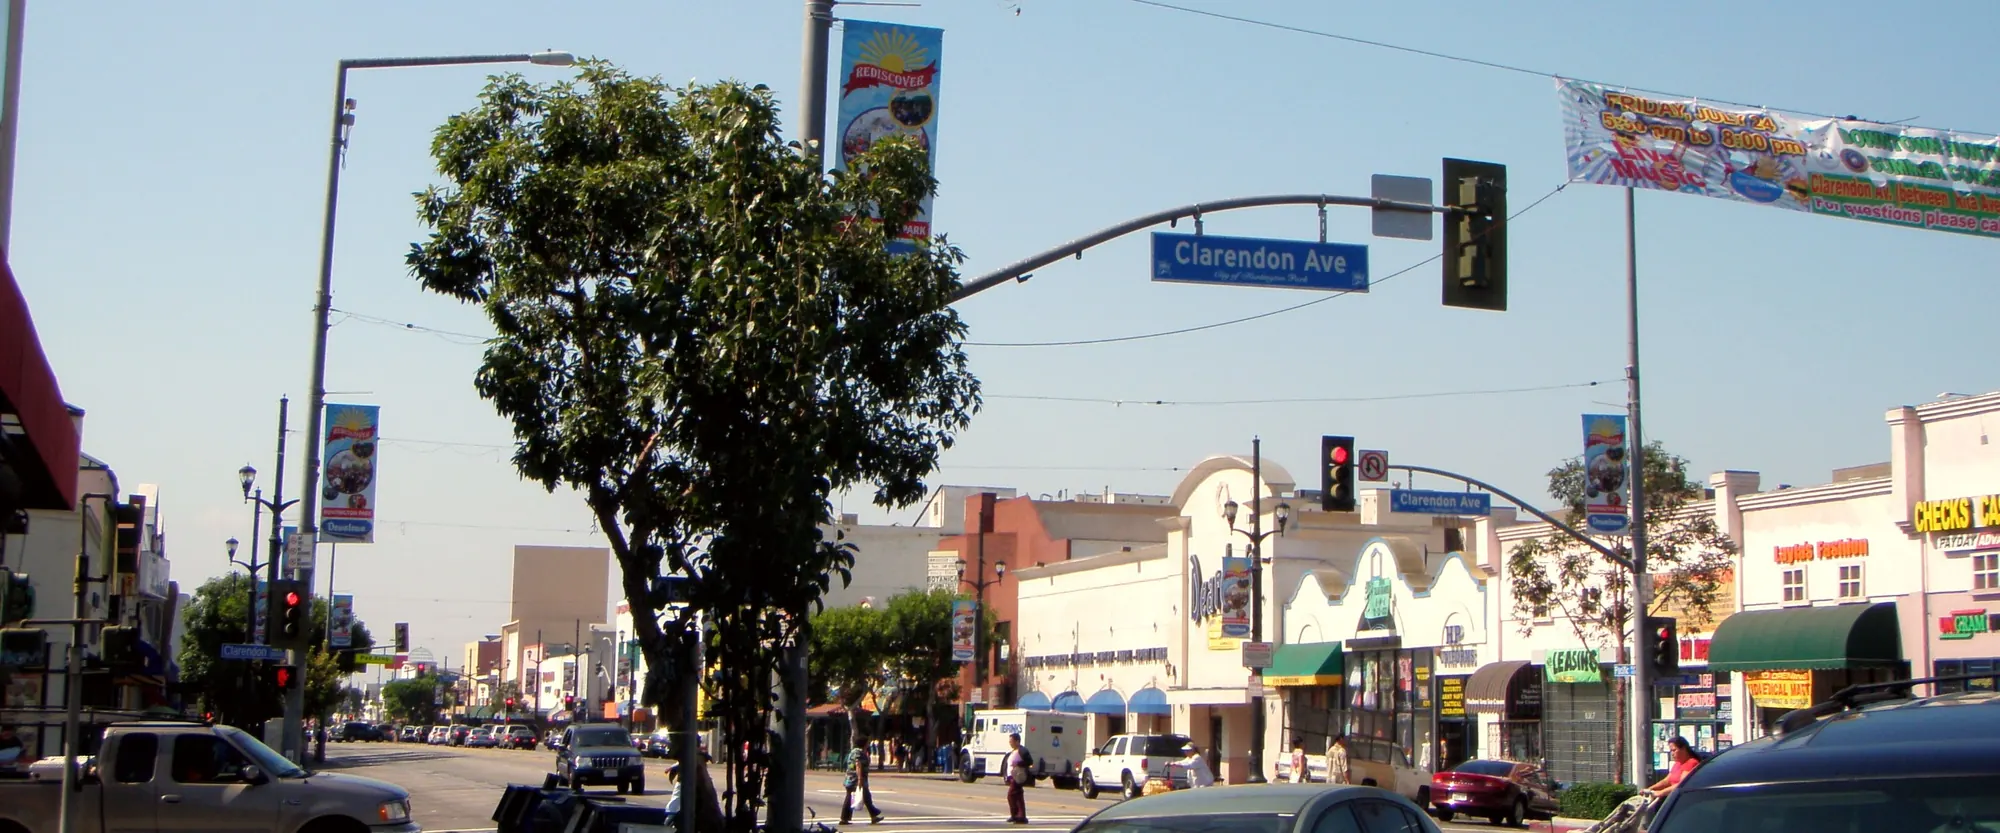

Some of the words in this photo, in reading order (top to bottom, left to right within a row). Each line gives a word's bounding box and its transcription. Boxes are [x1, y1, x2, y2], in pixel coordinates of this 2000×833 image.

[855, 66, 925, 87] REDISCOVER
[1604, 93, 1692, 122] FRIDAY,
[1696, 107, 1745, 127] JULY
[1748, 114, 1778, 133] 24
[1687, 126, 1712, 146] to
[1720, 128, 1768, 151] 8:00
[1769, 137, 1807, 156] pm
[1811, 173, 1873, 199] Clarendon
[1844, 203, 1922, 223] questions
[1926, 211, 1977, 229] please
[1175, 240, 1294, 270] Clarendon
[1303, 248, 1348, 274] Ave
[1400, 493, 1456, 507] Clarendon
[1460, 495, 1481, 508] Ave
[1914, 496, 1971, 532] CHECKS
[1816, 538, 1869, 560] Fashion
[1939, 535, 1977, 549] PAYDAY
[1445, 625, 1465, 645] HP
[223, 645, 268, 657] Clarendon
[1552, 650, 1599, 674] LEASING
